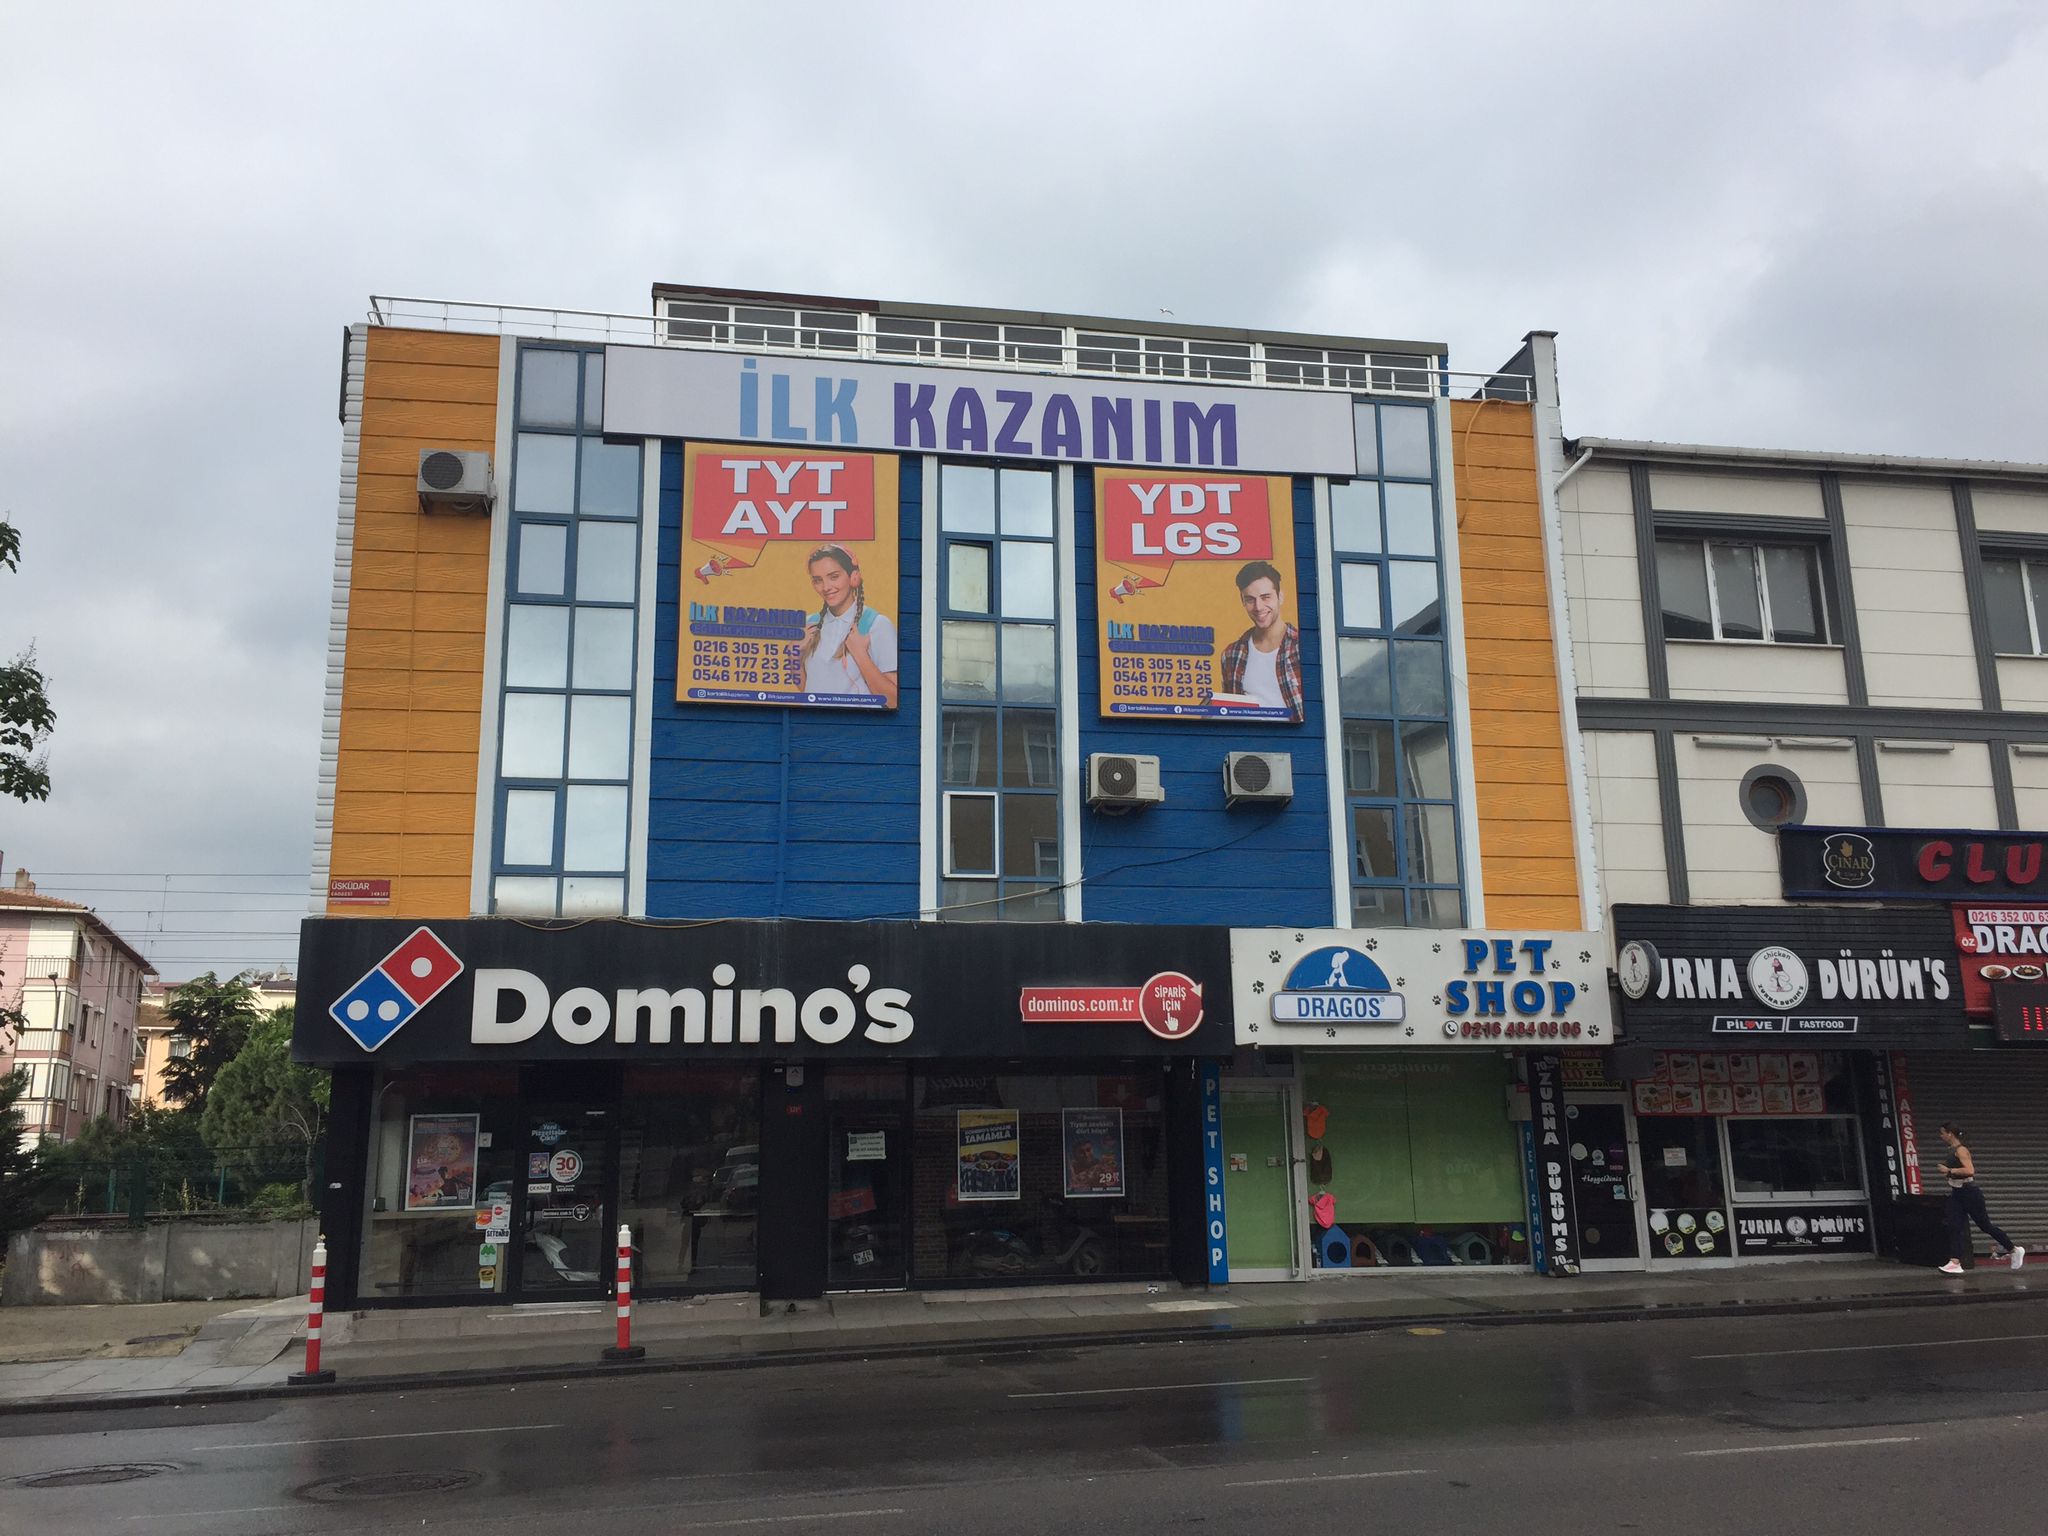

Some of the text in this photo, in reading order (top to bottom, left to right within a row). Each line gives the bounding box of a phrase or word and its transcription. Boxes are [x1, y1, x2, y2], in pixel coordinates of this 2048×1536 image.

[740, 358, 1238, 466] İLK KAZANIM
[721, 460, 844, 494] TYT
[1128, 484, 1241, 515] YDT
[721, 501, 848, 534] AYT
[1132, 522, 1242, 555] LGS
[693, 640, 800, 657] 0216 305 15 45
[693, 654, 800, 671] 0546 177 23 25
[1113, 657, 1211, 671] 0216 305 15 45
[692, 669, 801, 685] 0546 178 23 25
[1113, 671, 1212, 685] 0546 177 23 25
[1114, 685, 1214, 699] 0546 178 23 25
[331, 880, 370, 890] ÜSKÜDAR
[1971, 911, 1998, 923] 0216
[2001, 911, 2020, 923] 352
[2023, 911, 2035, 923] 00
[1961, 936, 1976, 947] ÖZ
[1461, 939, 1553, 975] PET
[1656, 958, 1743, 1000] URNA
[1817, 949, 1950, 1000] DÜRÜM'S
[1154, 984, 1187, 1001] SİPARİŞ
[1445, 980, 1576, 1016] SHOP
[470, 962, 915, 1045] Domino's
[1028, 996, 1134, 1013] dominos.com.tr
[1162, 998, 1181, 1013] İÇİN
[1297, 997, 1382, 1018] DRAGOS
[1461, 1021, 1581, 1038] 0216 484 08 06
[1800, 1020, 1844, 1029] FASTFOOD
[1538, 1072, 1560, 1146] ZURNA
[965, 1130, 1012, 1144] TAMAMLA
[555, 1156, 577, 1171] 30
[1206, 1078, 1225, 1267] PET SHOP
[1739, 1218, 1784, 1235] ZURNA
